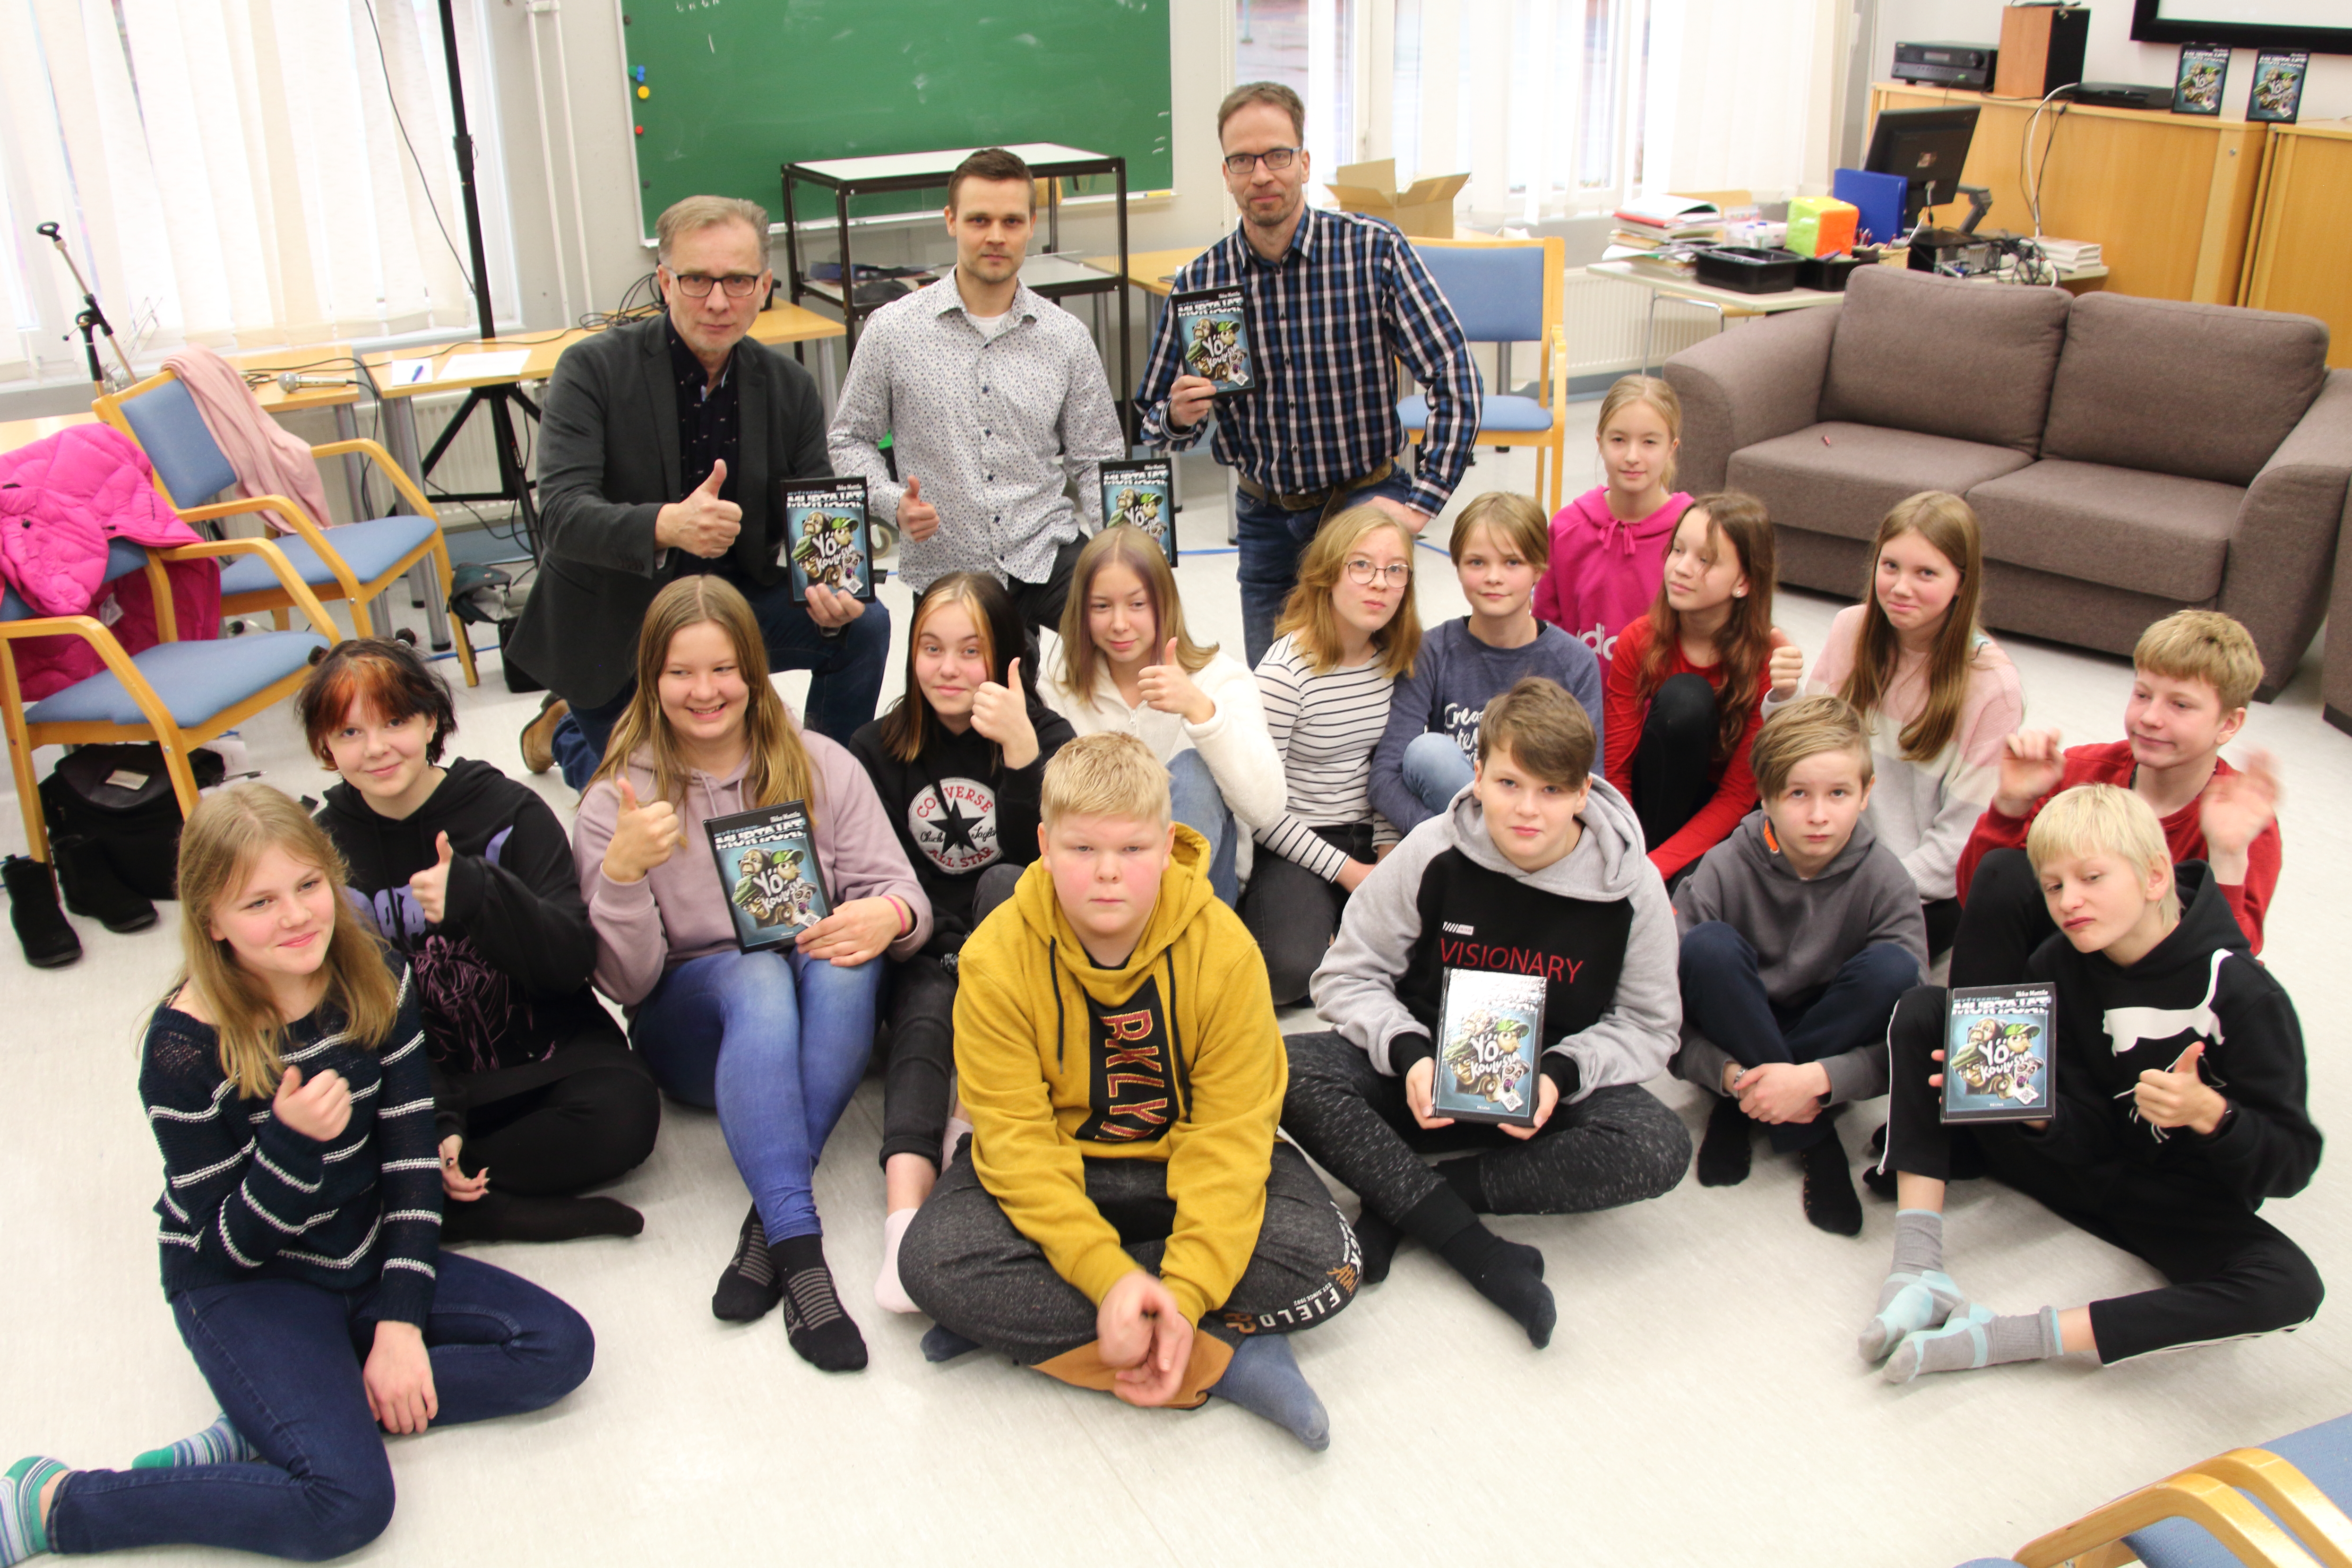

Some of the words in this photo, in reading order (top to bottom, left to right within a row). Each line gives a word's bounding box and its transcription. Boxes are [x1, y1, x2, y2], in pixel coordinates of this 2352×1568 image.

[1202, 335, 1223, 357] YÖ
[812, 531, 837, 558] YÖ
[816, 544, 856, 574] KOULUSSA
[916, 786, 993, 818] COVERSE
[920, 831, 943, 843] Chuck
[971, 826, 996, 842] Taylo
[928, 849, 955, 867] ALL
[961, 847, 994, 867] STAR
[752, 867, 784, 897] YÖ
[761, 877, 805, 913] KOULUSSA
[1440, 938, 1584, 984] VISIONARY
[1952, 996, 2051, 1015] MURTAJAT
[1470, 1034, 1499, 1063] YÖ
[1978, 1038, 2010, 1066] YÖ
[1470, 1052, 1522, 1080] KOULUSSA
[1980, 1051, 2033, 1082] KOULUSSA
[1259, 1286, 1341, 1327] FIELD
